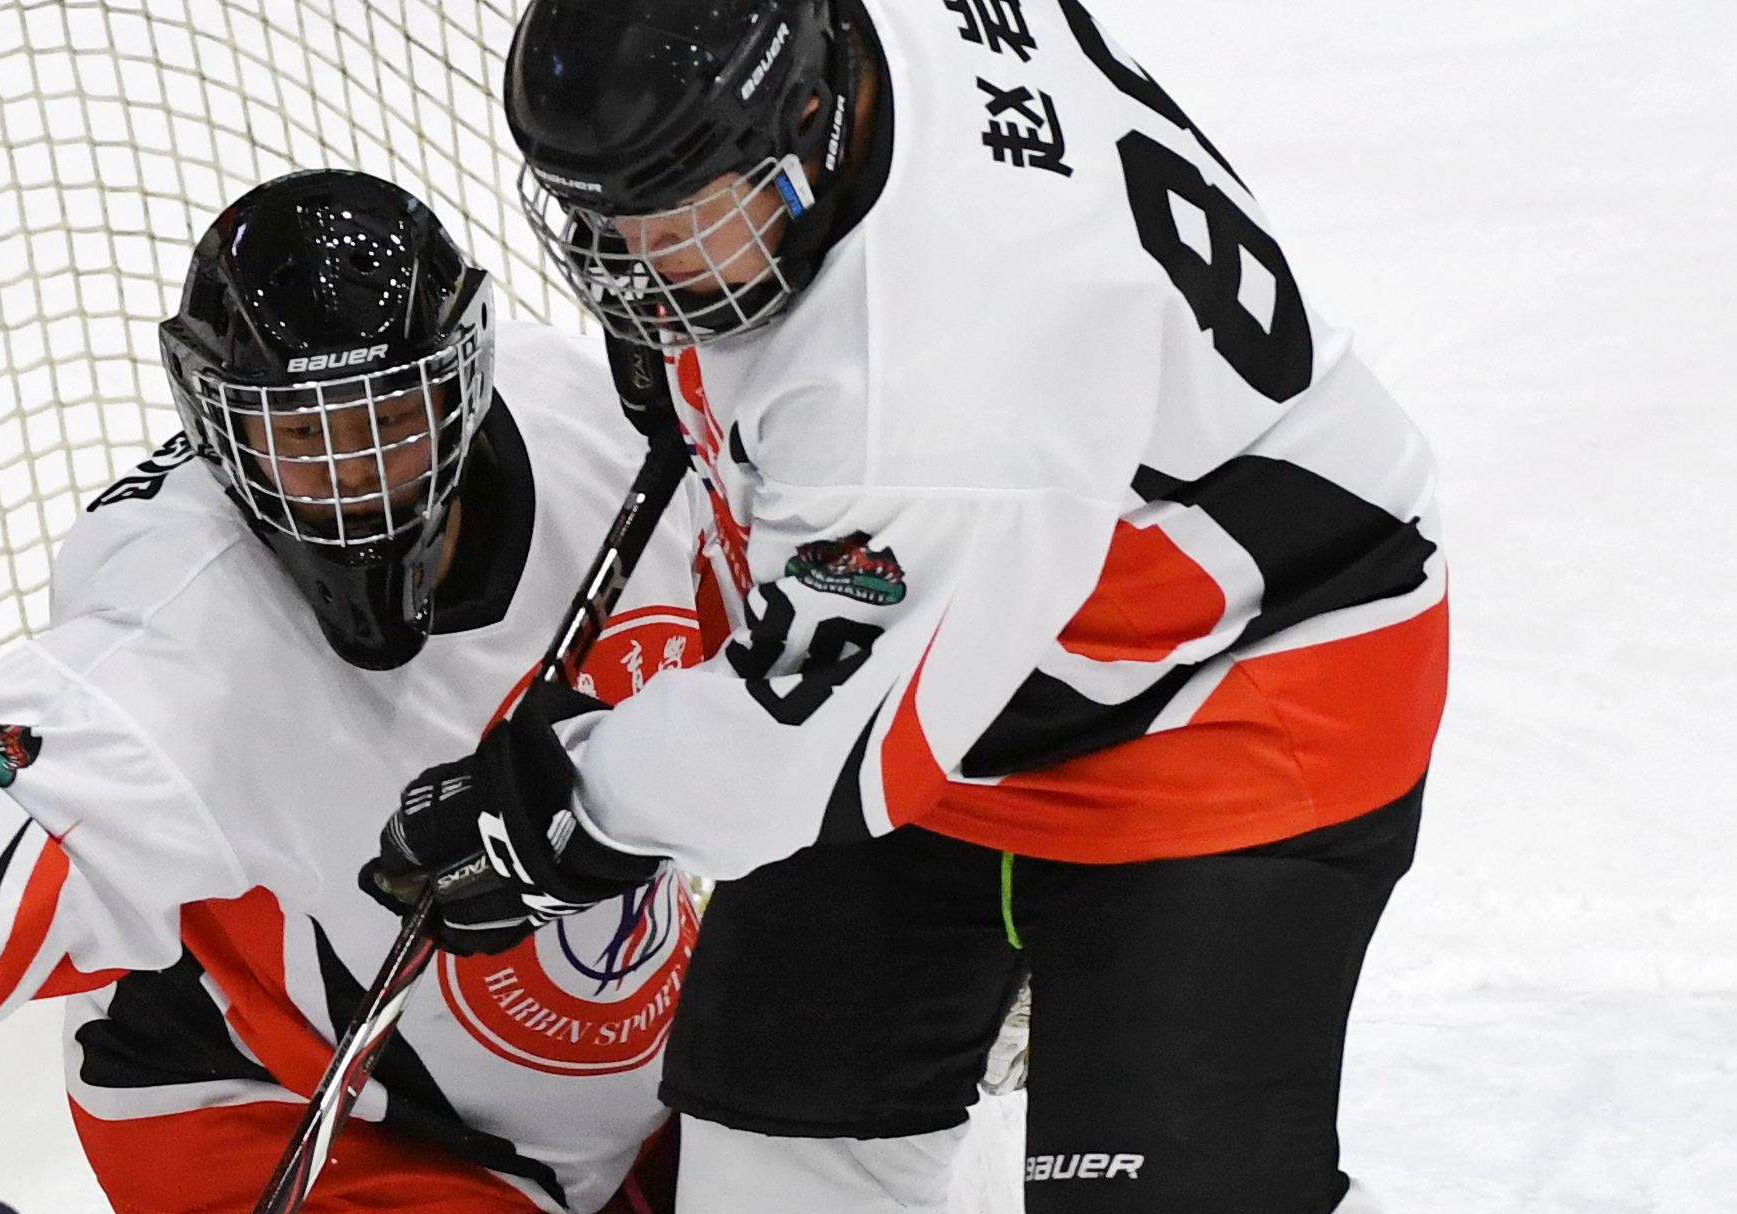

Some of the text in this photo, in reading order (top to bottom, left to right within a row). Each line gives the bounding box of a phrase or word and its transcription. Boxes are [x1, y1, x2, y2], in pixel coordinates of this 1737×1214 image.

[741, 21, 790, 100] BAUER
[824, 94, 846, 172] BAUER
[286, 343, 389, 373] BAUER
[437, 855, 488, 891] TACKS
[483, 966, 591, 1045] HARBIN
